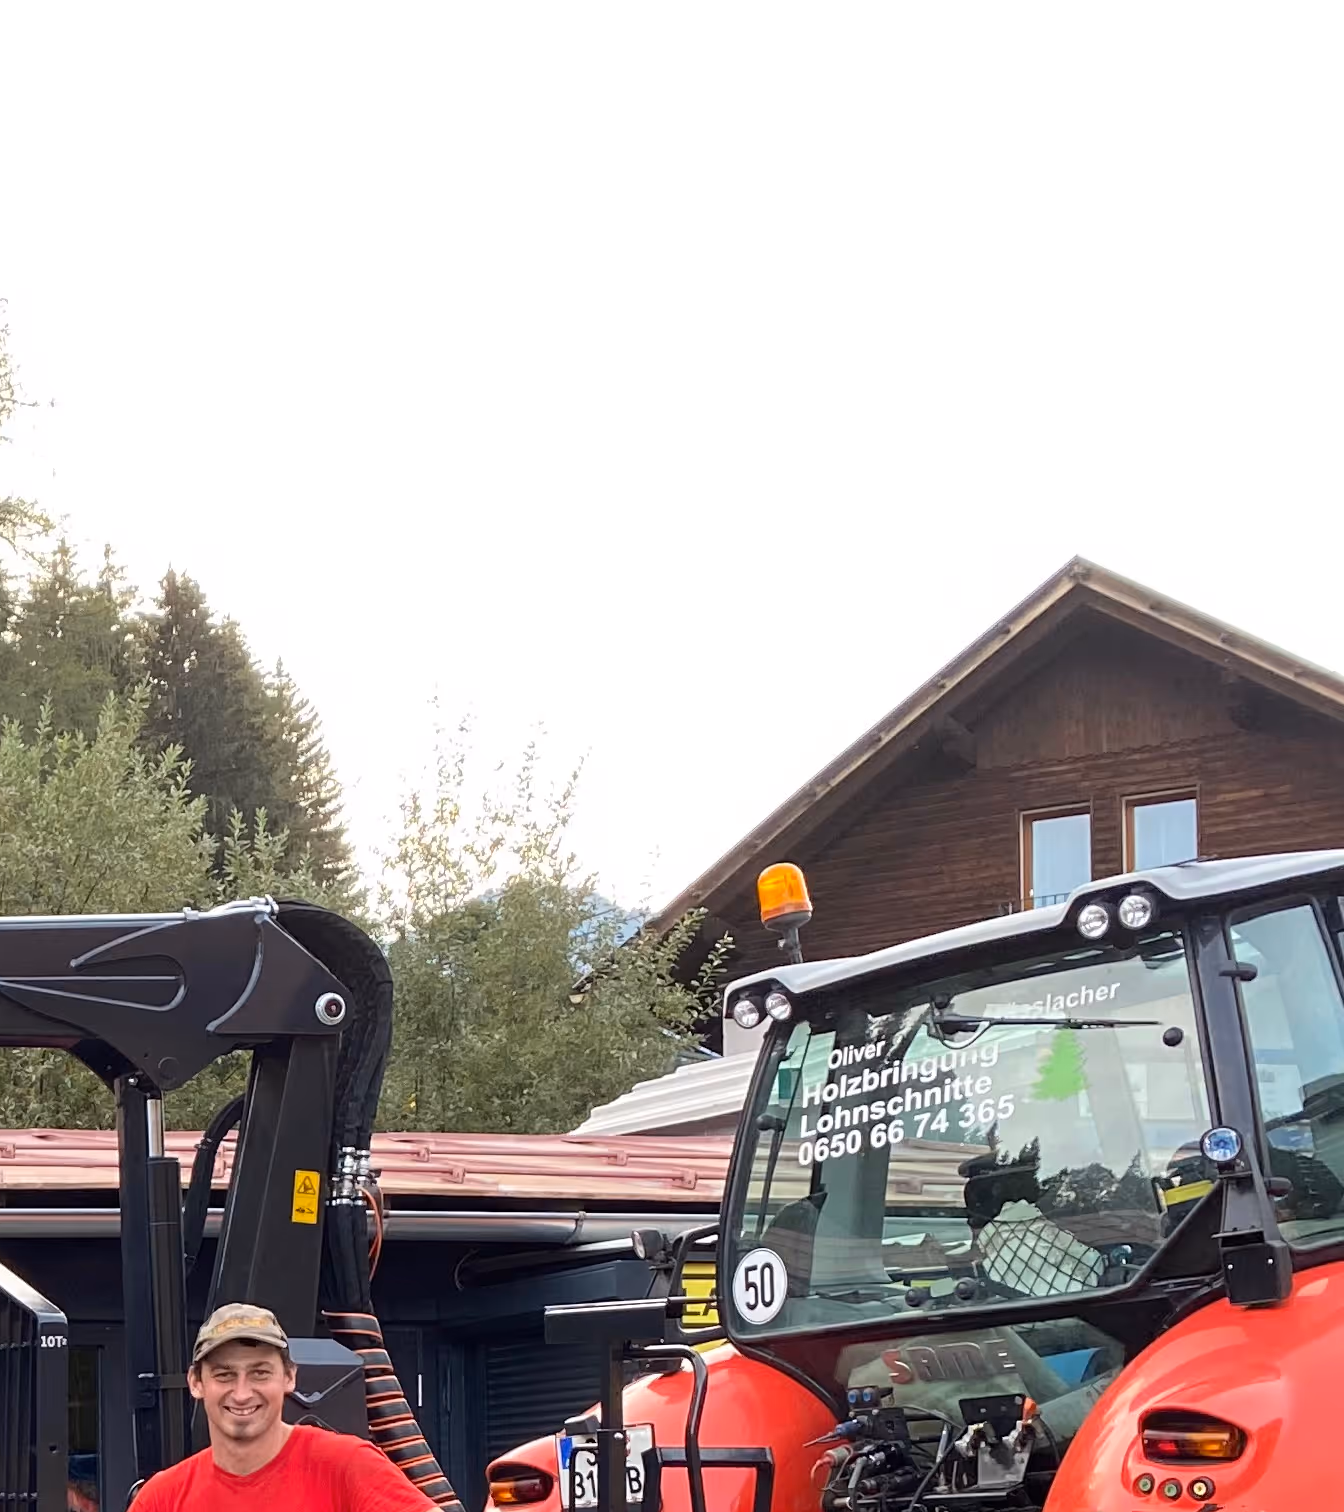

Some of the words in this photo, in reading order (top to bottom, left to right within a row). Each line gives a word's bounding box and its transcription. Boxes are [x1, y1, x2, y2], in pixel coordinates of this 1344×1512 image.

[801, 1043, 1000, 1108] Holzbringung
[827, 1041, 886, 1070] Oliver
[798, 1130, 862, 1166] 0650
[870, 1119, 905, 1150] 66
[915, 1110, 950, 1138] 74
[958, 1094, 1015, 1127] 365
[800, 1074, 993, 1138] Lohnschnitte
[744, 1262, 775, 1311] 50
